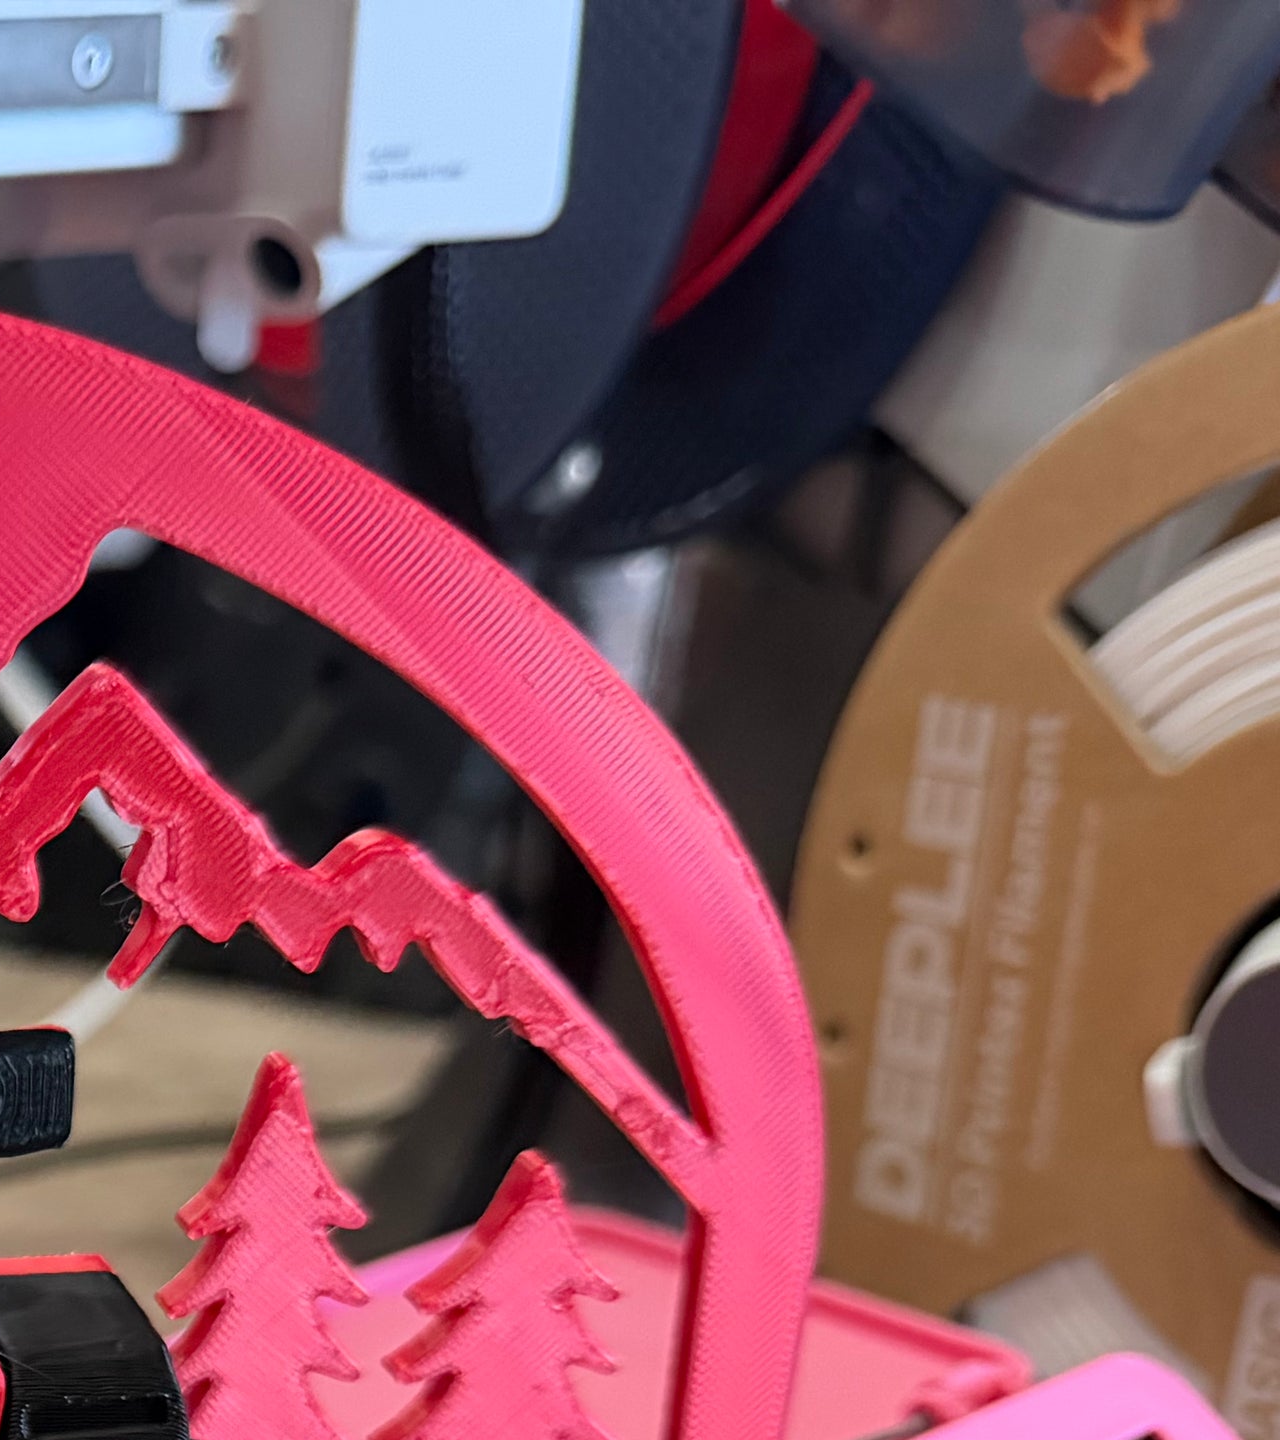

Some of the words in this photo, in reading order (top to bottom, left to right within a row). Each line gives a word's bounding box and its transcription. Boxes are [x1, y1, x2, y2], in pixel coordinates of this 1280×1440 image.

[989, 711, 1066, 964] Filament
[855, 692, 997, 1222] DEEPLEE
[957, 976, 1035, 1167] Printer
[944, 1172, 998, 1246] 3D
